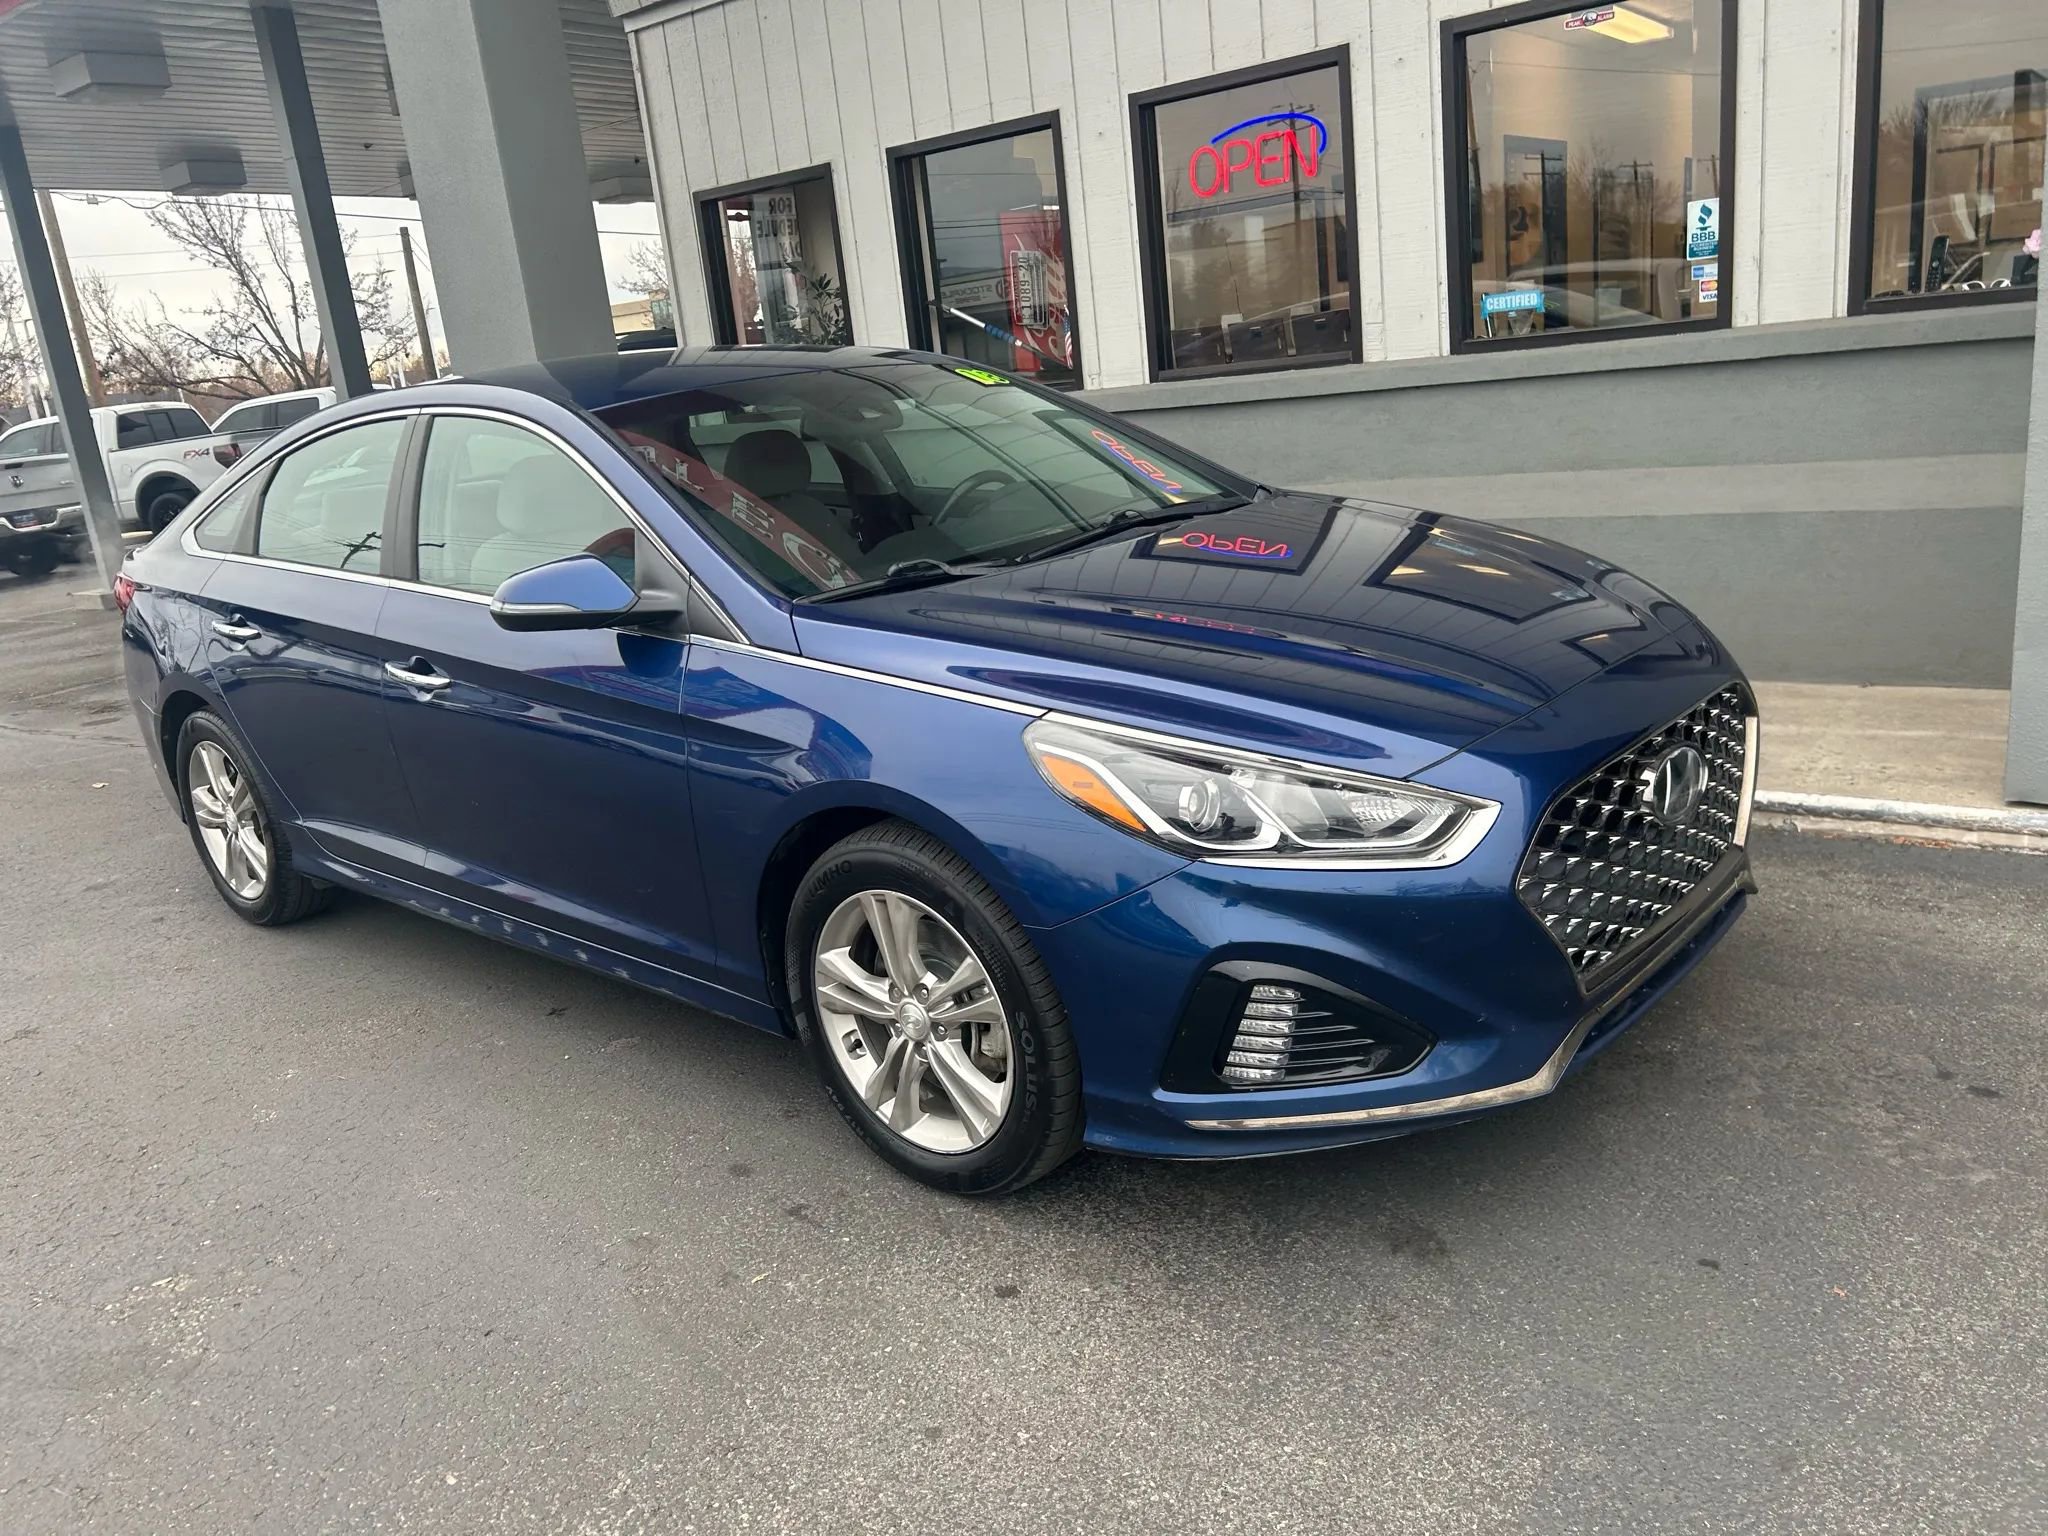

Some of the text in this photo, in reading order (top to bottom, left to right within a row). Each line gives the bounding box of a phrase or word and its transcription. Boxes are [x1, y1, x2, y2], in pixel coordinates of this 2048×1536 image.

[1189, 124, 1317, 198] OPEN
[1691, 231, 1716, 243] BBB
[1487, 293, 1537, 310] CERTIFIED
[184, 447, 210, 459] FX4
[1015, 1011, 1038, 1111] SOLUS
